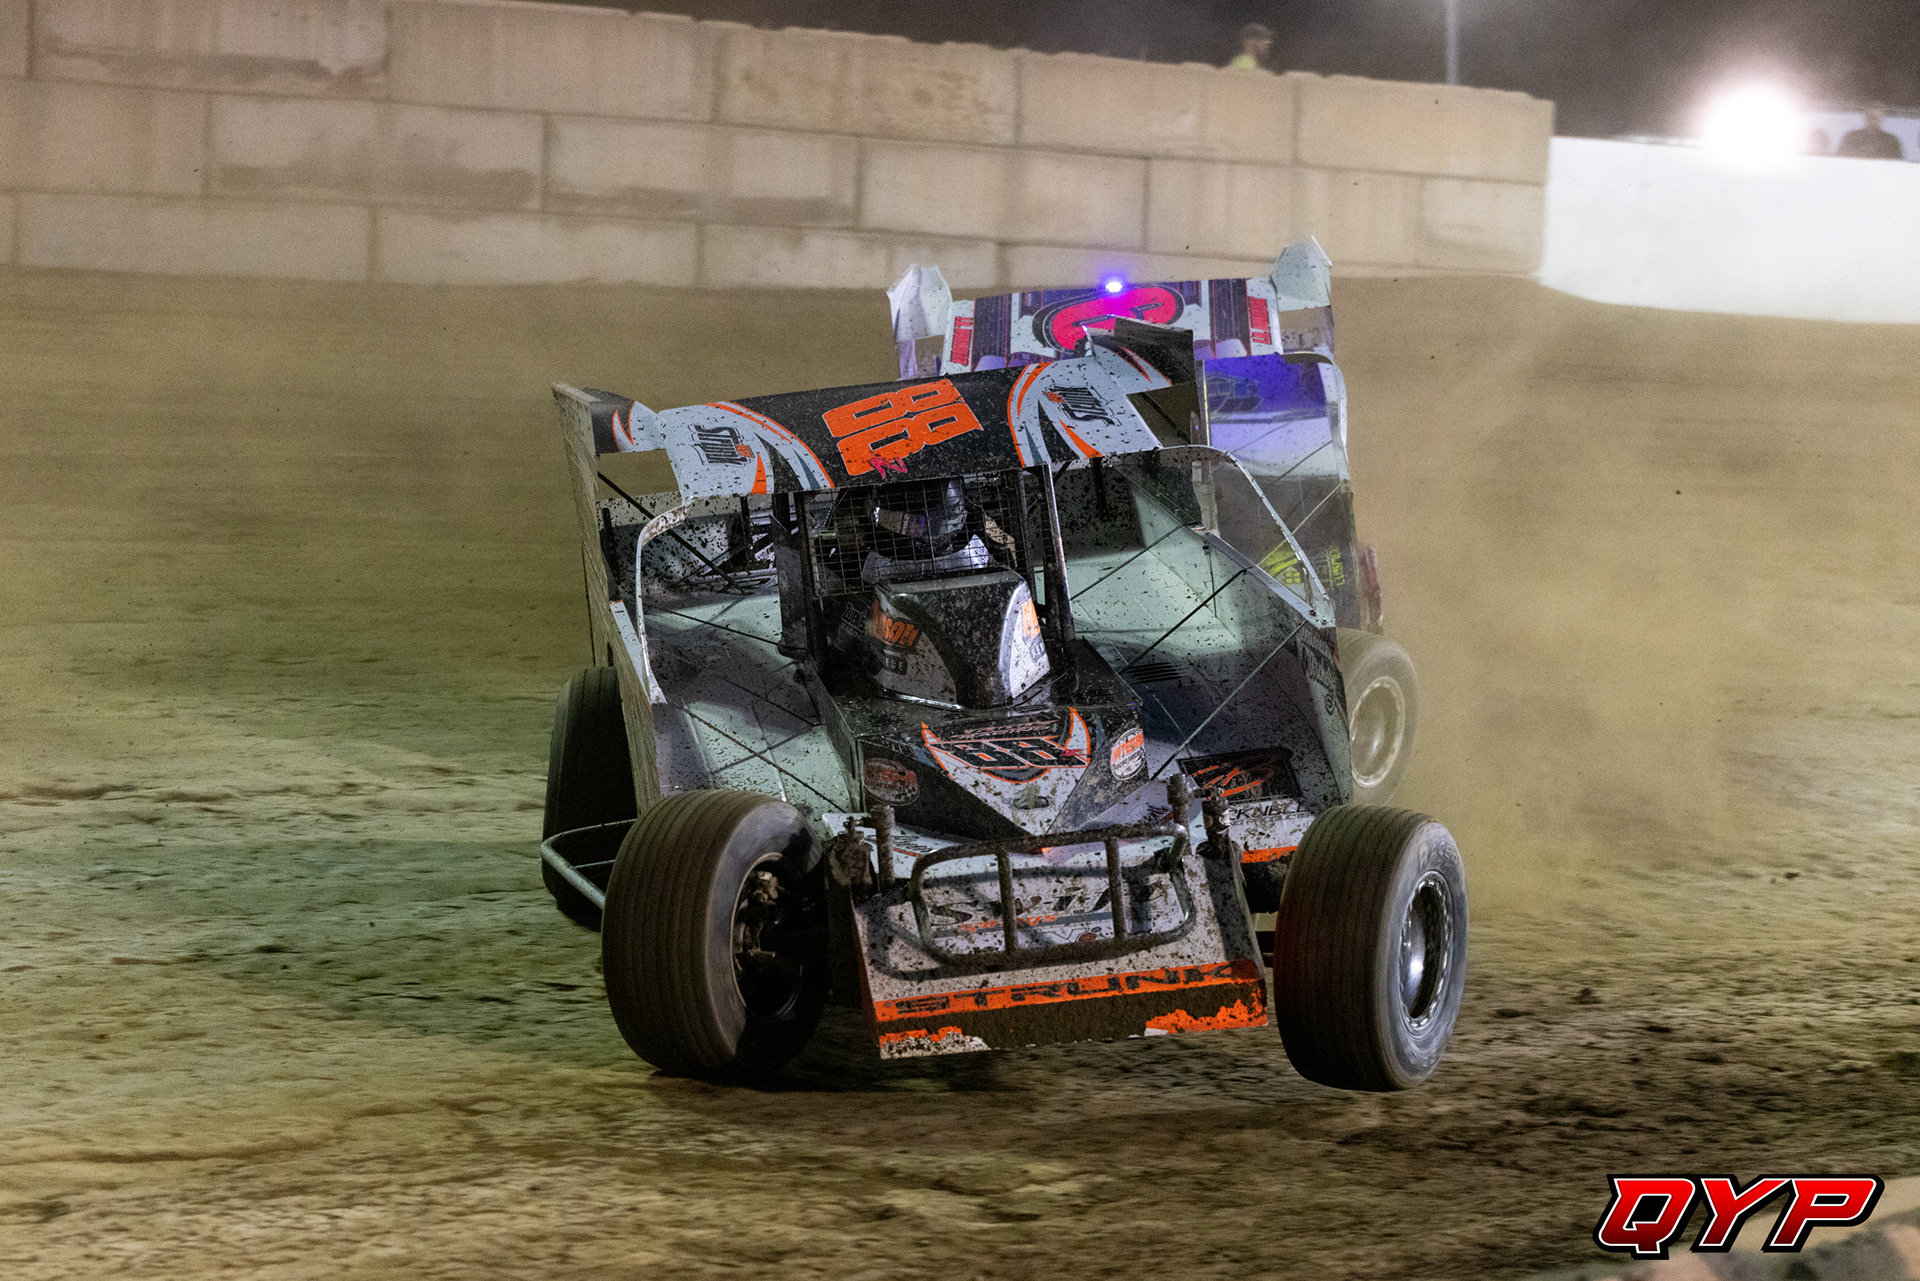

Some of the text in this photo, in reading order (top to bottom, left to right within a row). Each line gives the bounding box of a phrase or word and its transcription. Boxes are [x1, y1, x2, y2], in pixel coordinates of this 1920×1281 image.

[822, 379, 984, 475] 88
[958, 914, 1058, 933] sprgs
[896, 963, 1232, 1013] STRUNK
